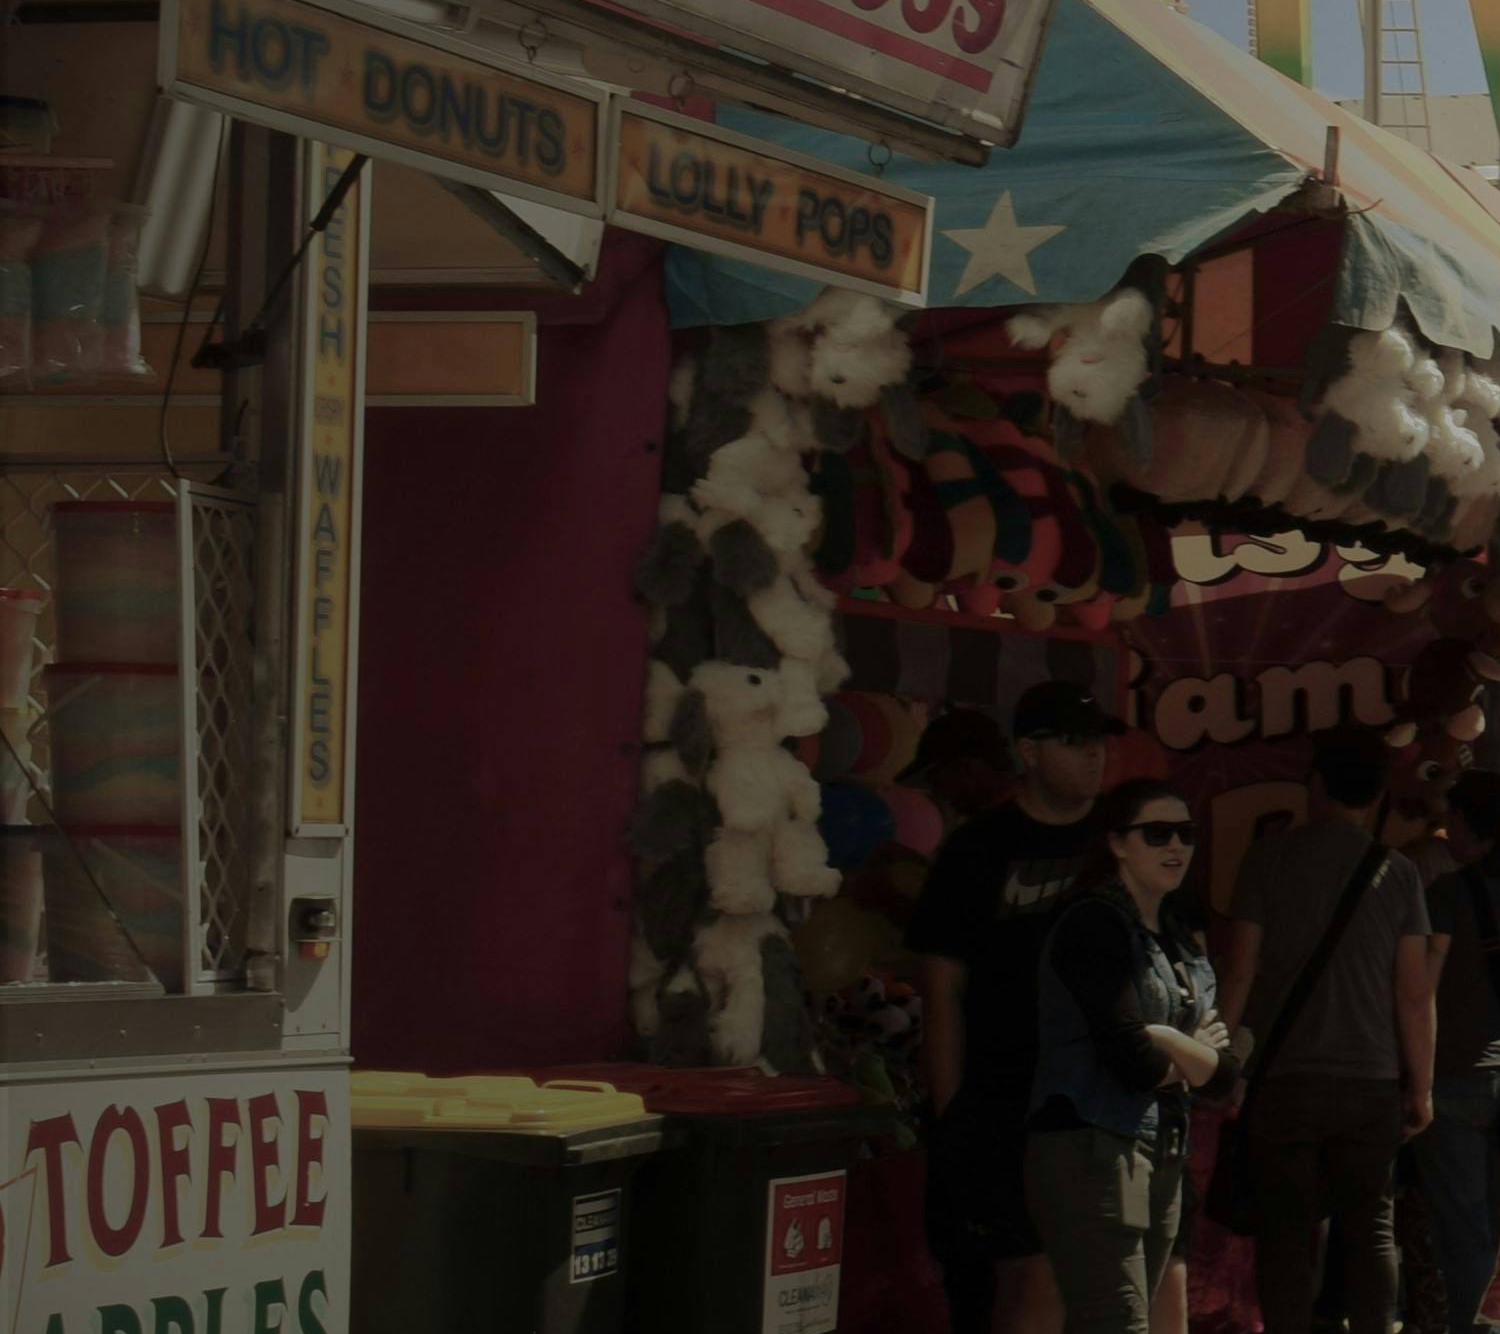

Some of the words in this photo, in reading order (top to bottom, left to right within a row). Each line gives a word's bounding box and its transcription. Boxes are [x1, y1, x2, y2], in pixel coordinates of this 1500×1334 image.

[361, 46, 568, 177] DONUTS
[646, 141, 775, 237] LOLLY
[796, 184, 894, 271] POPS
[308, 449, 343, 784] WAFFLES
[23, 1088, 330, 1269] TOFFEE
